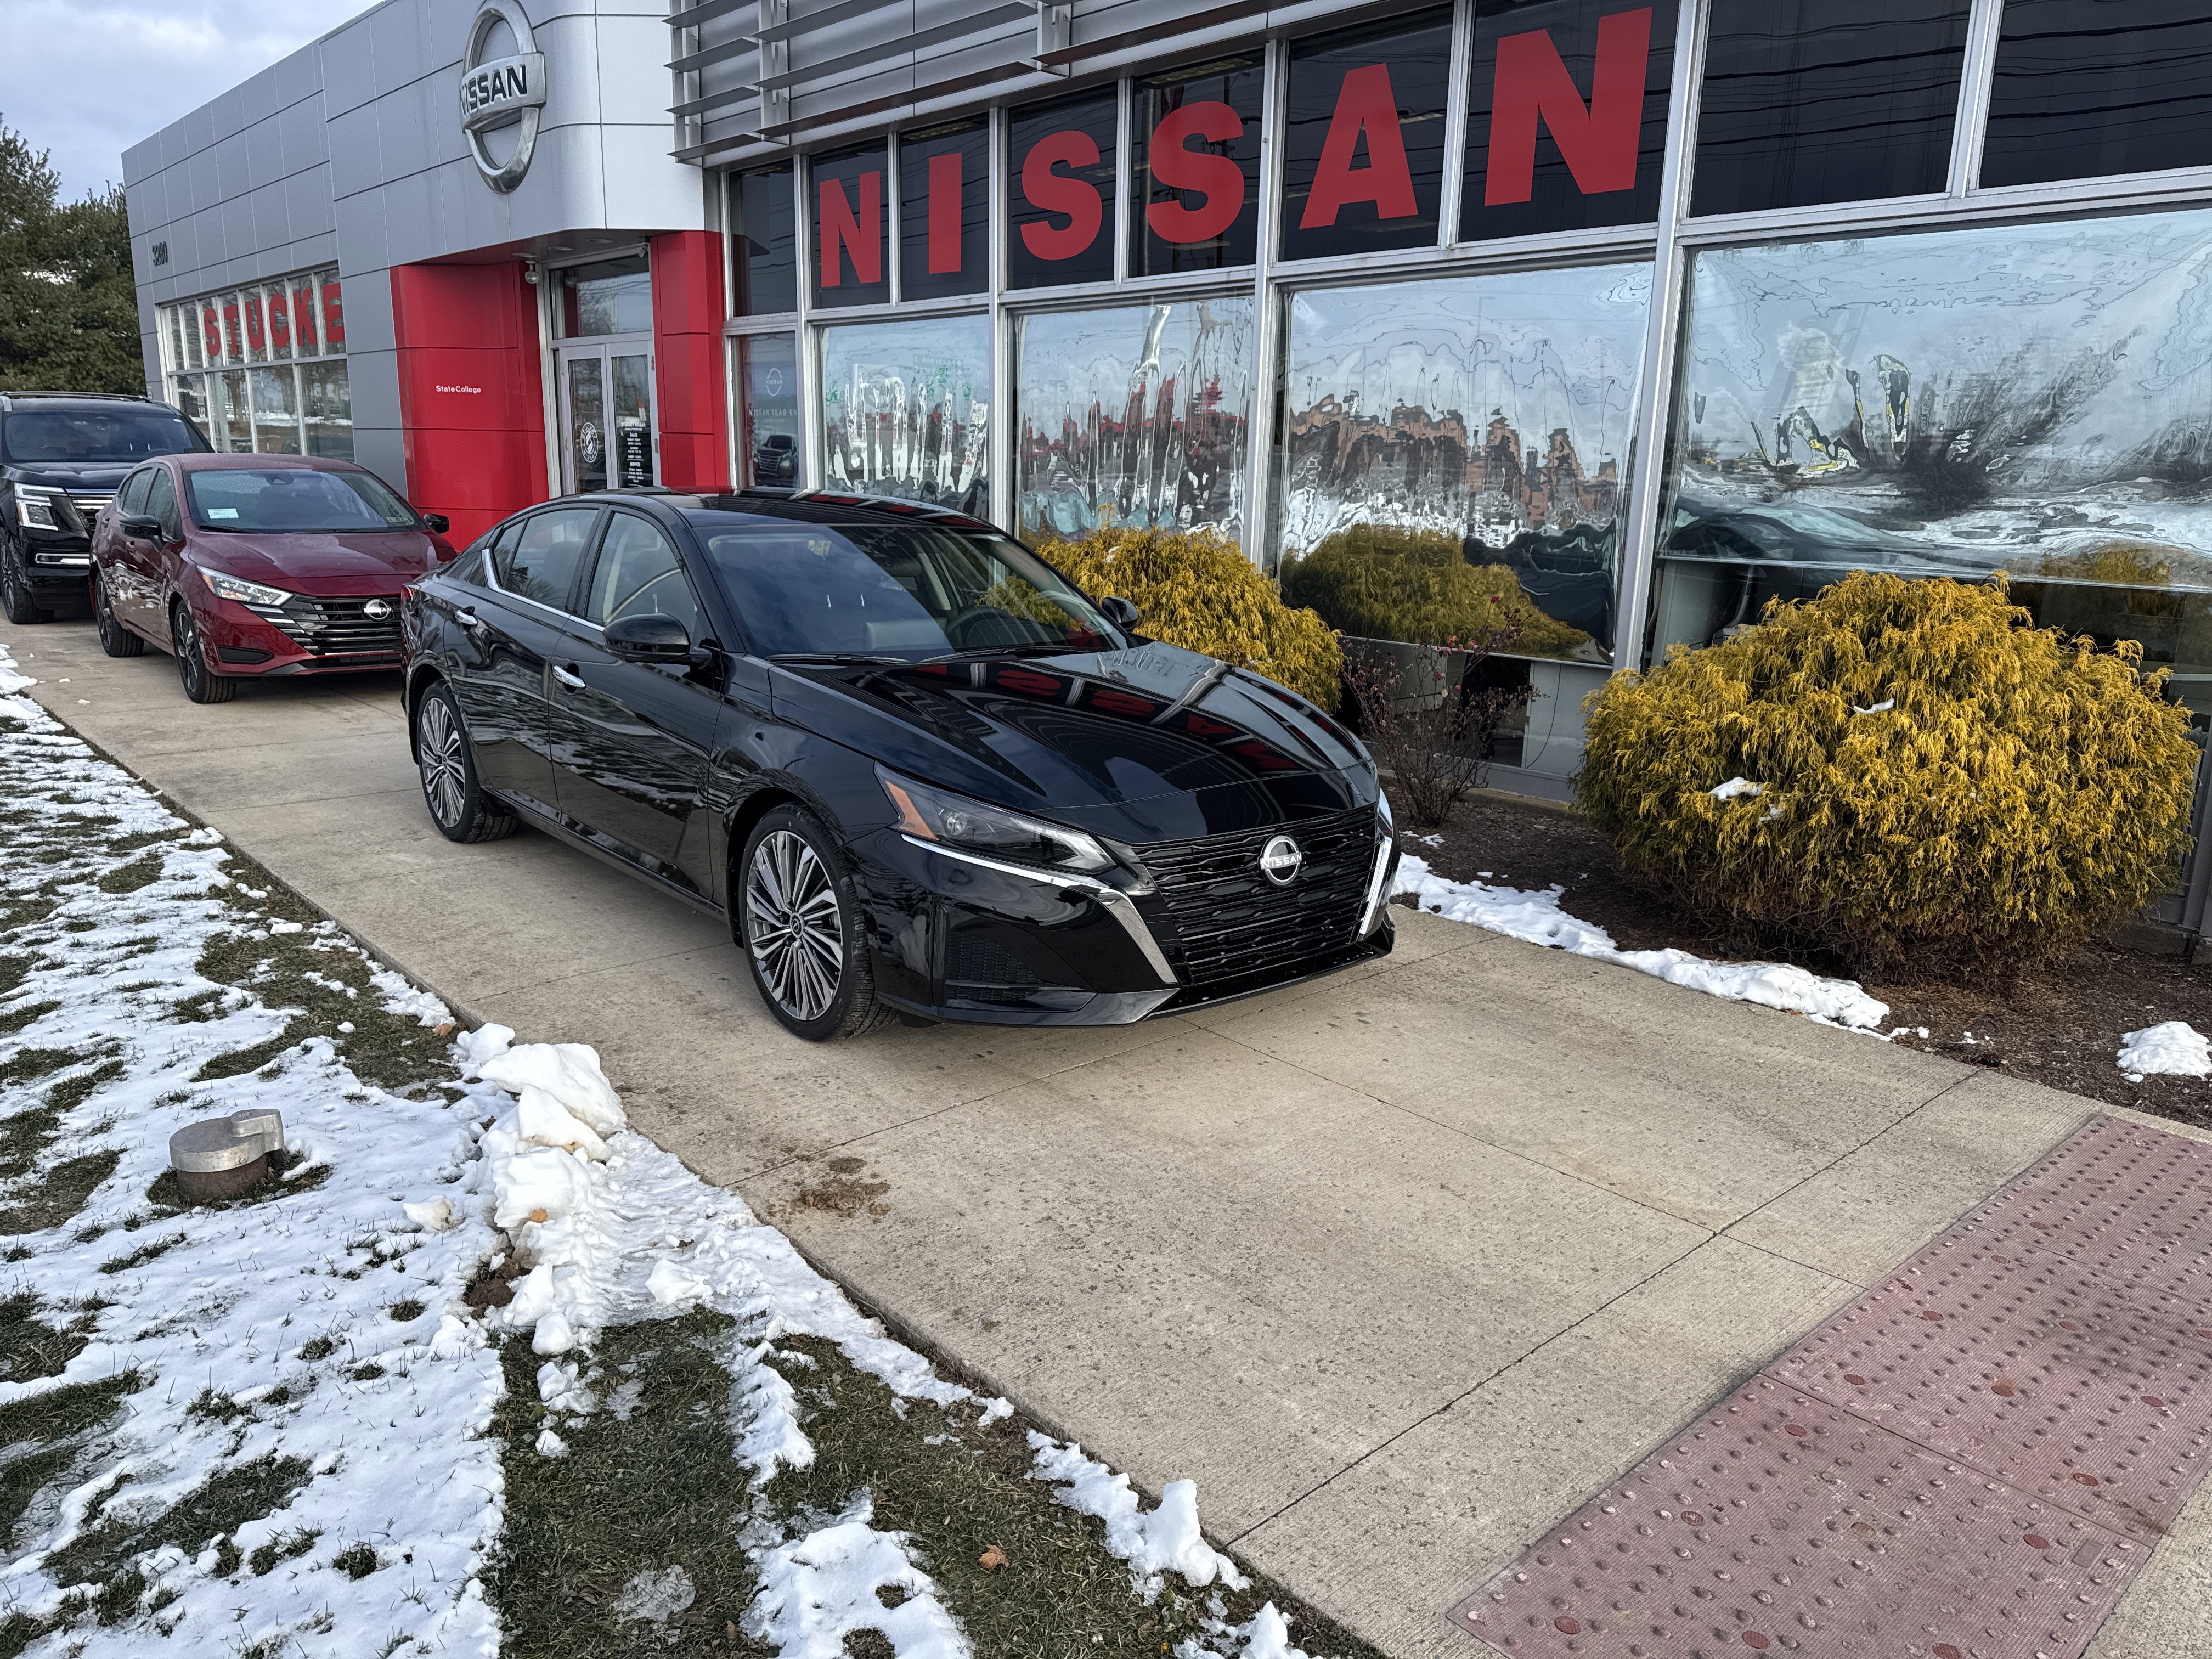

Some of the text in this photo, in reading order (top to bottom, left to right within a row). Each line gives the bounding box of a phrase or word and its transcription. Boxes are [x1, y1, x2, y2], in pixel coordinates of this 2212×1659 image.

[459, 64, 527, 116] NISSAN
[820, 7, 1653, 287] NISSAN
[152, 241, 168, 267] 3280
[1262, 854, 1302, 868] NISSAN
